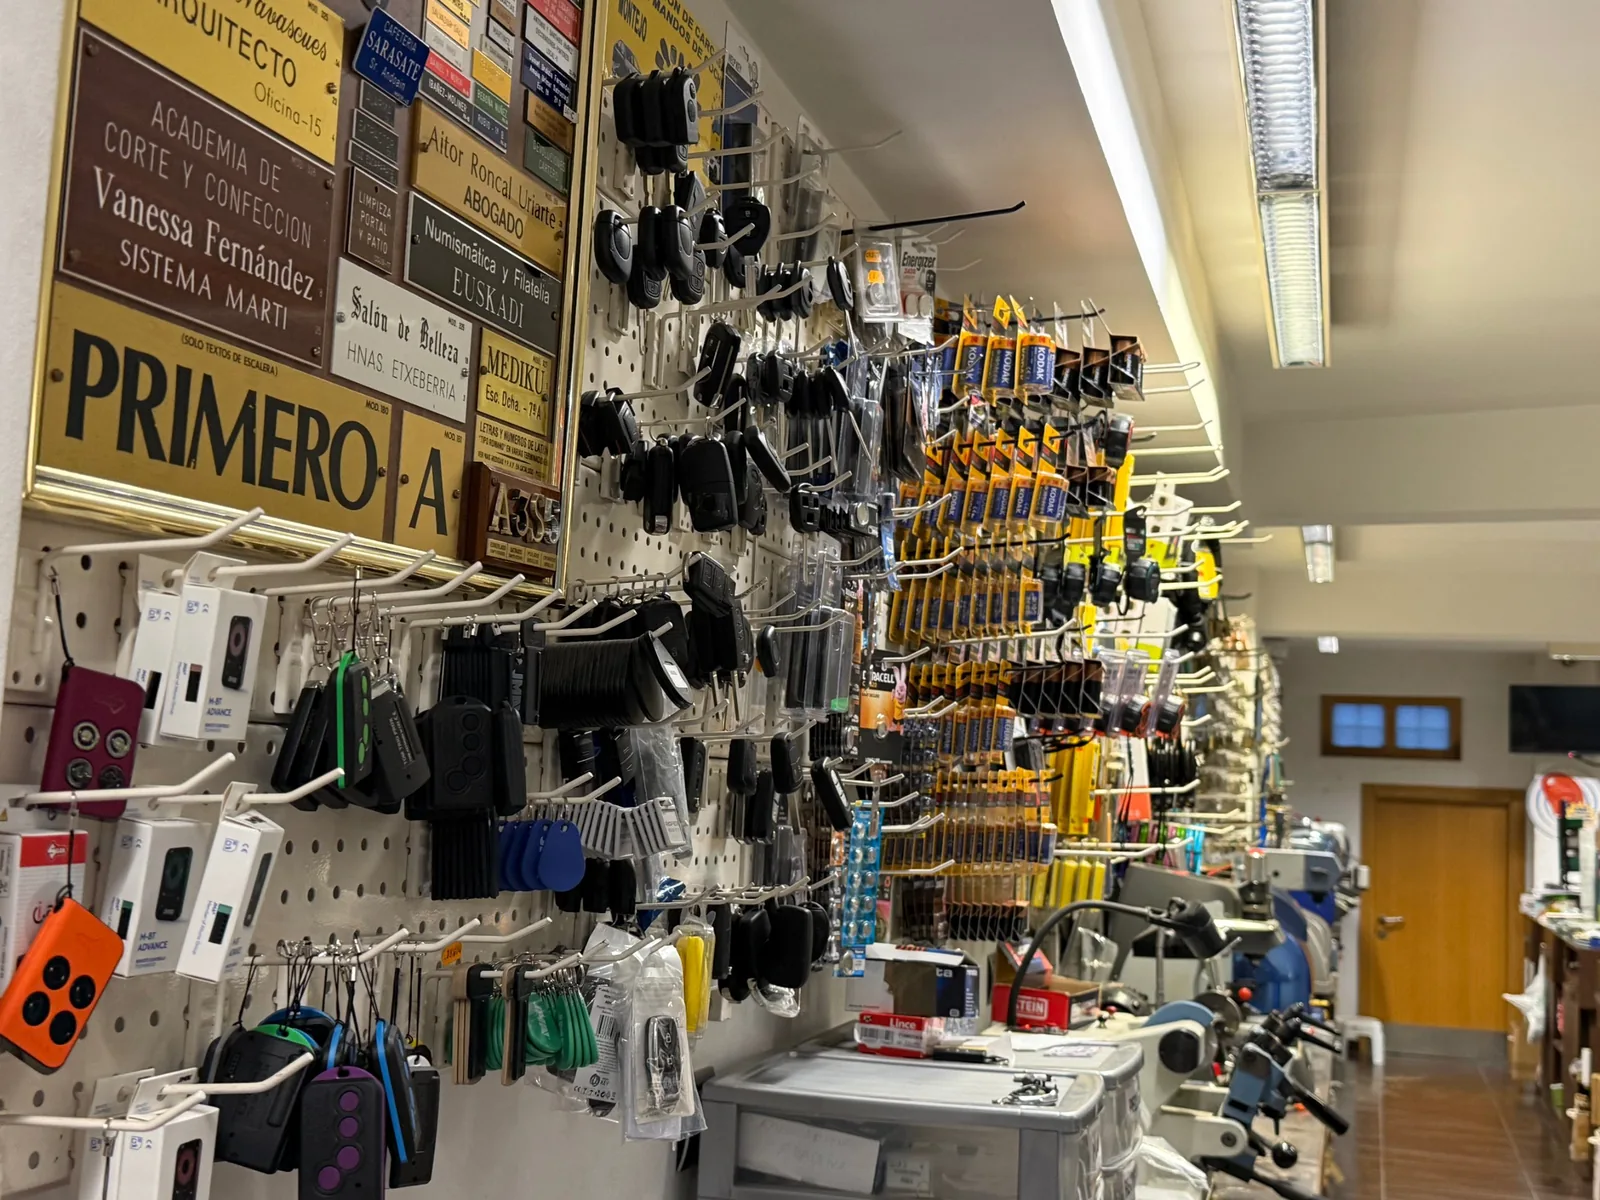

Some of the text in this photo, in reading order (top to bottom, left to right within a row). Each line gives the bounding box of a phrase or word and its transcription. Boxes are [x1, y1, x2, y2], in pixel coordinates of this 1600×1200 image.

[236, 0, 327, 61] avascues
[384, 21, 417, 53] CAFETERIA
[652, 0, 690, 44] MANDOS
[692, 40, 703, 60] DE
[682, 10, 694, 30] DE
[157, 0, 297, 87] QUITECTO
[366, 31, 421, 81] SARASATE
[253, 81, 322, 138] Oficina-15
[152, 101, 281, 193] ACADEMIA DE
[105, 122, 312, 249] CORTE Y CONFECCION
[428, 126, 464, 167] Aitor
[471, 152, 512, 200] Roncal
[518, 185, 556, 230] Uriarte
[358, 190, 392, 220] LIMPIEZA
[360, 210, 388, 237] PORTAL
[464, 186, 524, 240] ABOGADO
[93, 165, 315, 301] Vanessa Fernández
[358, 229, 388, 254] Y PATIO
[425, 215, 550, 305] Numismática y Filatelia
[902, 251, 936, 271] Energizer
[119, 239, 289, 331] SISTEMA MARTI
[452, 266, 524, 328] EUSKADI
[351, 285, 459, 365] Salón de Belleza
[181, 333, 279, 376] (SOLO TEXTOS DE ESCALERA)
[347, 341, 456, 401] HNAS. ETXEBERRIA
[487, 345, 544, 395] MEDIKU
[965, 346, 977, 380] KODAK
[1001, 351, 1012, 384] KODAK
[1036, 346, 1046, 380] KODAK
[365, 400, 380, 413] MOD.
[485, 384, 500, 403] Esc.
[502, 391, 520, 412] Dcha.
[65, 328, 378, 510] PRIMERO
[479, 421, 498, 437] LETRAS
[408, 446, 448, 536] A
[948, 490, 959, 516] KODAK
[1015, 488, 1025, 514] KODAK
[1047, 487, 1058, 514] KODAK
[206, 707, 232, 717] ADVANCE
[137, 941, 168, 952] ADVANCE
[139, 932, 156, 941] M-BT
[890, 1017, 917, 1029] Lince
